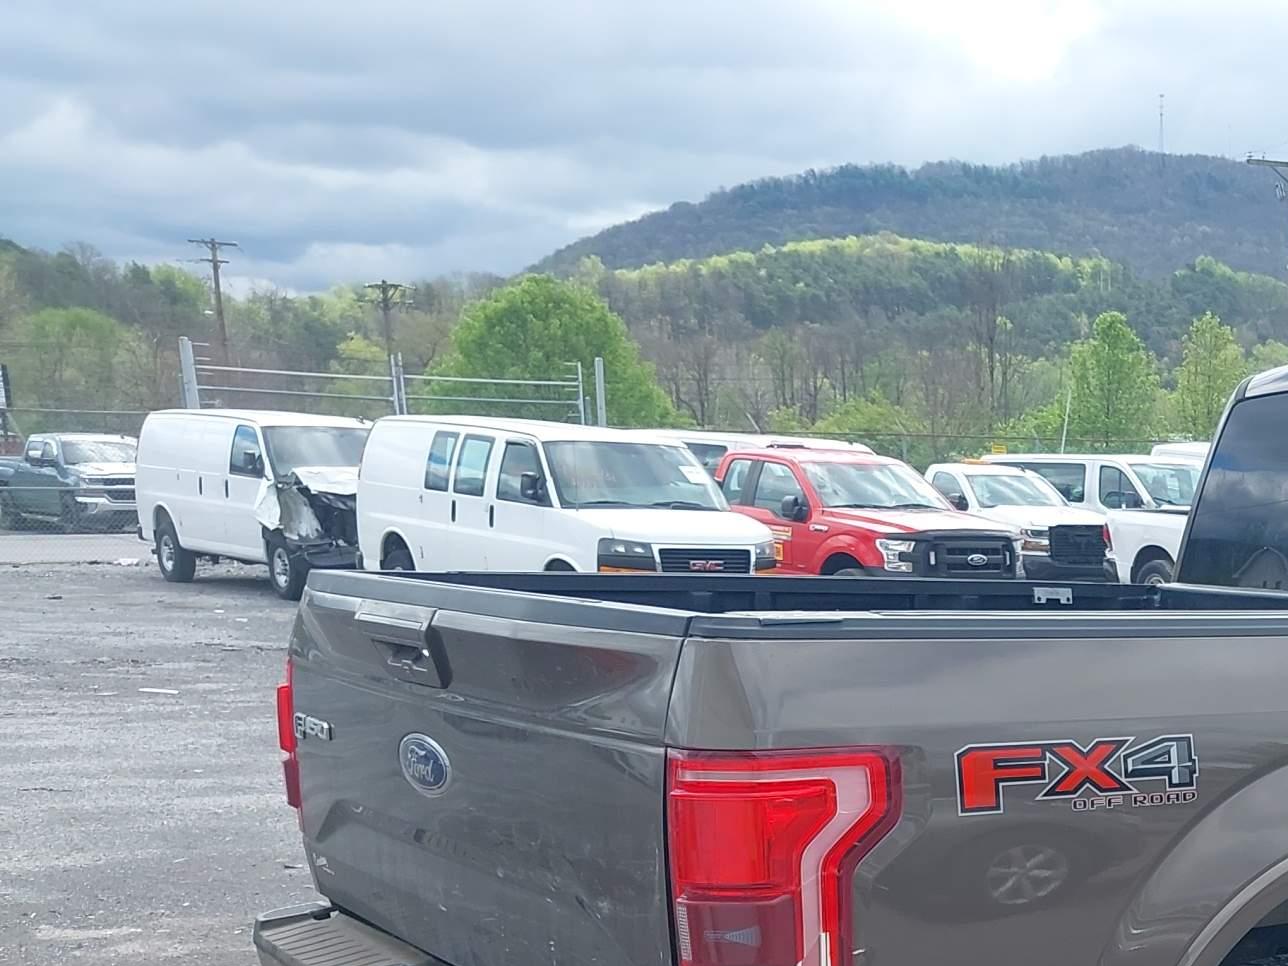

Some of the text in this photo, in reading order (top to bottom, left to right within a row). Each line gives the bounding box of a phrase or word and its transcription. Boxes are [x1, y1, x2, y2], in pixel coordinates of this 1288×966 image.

[407, 745, 435, 782] Ford
[954, 734, 1199, 816] FX4
[1071, 790, 1199, 812] OFF ROAD
